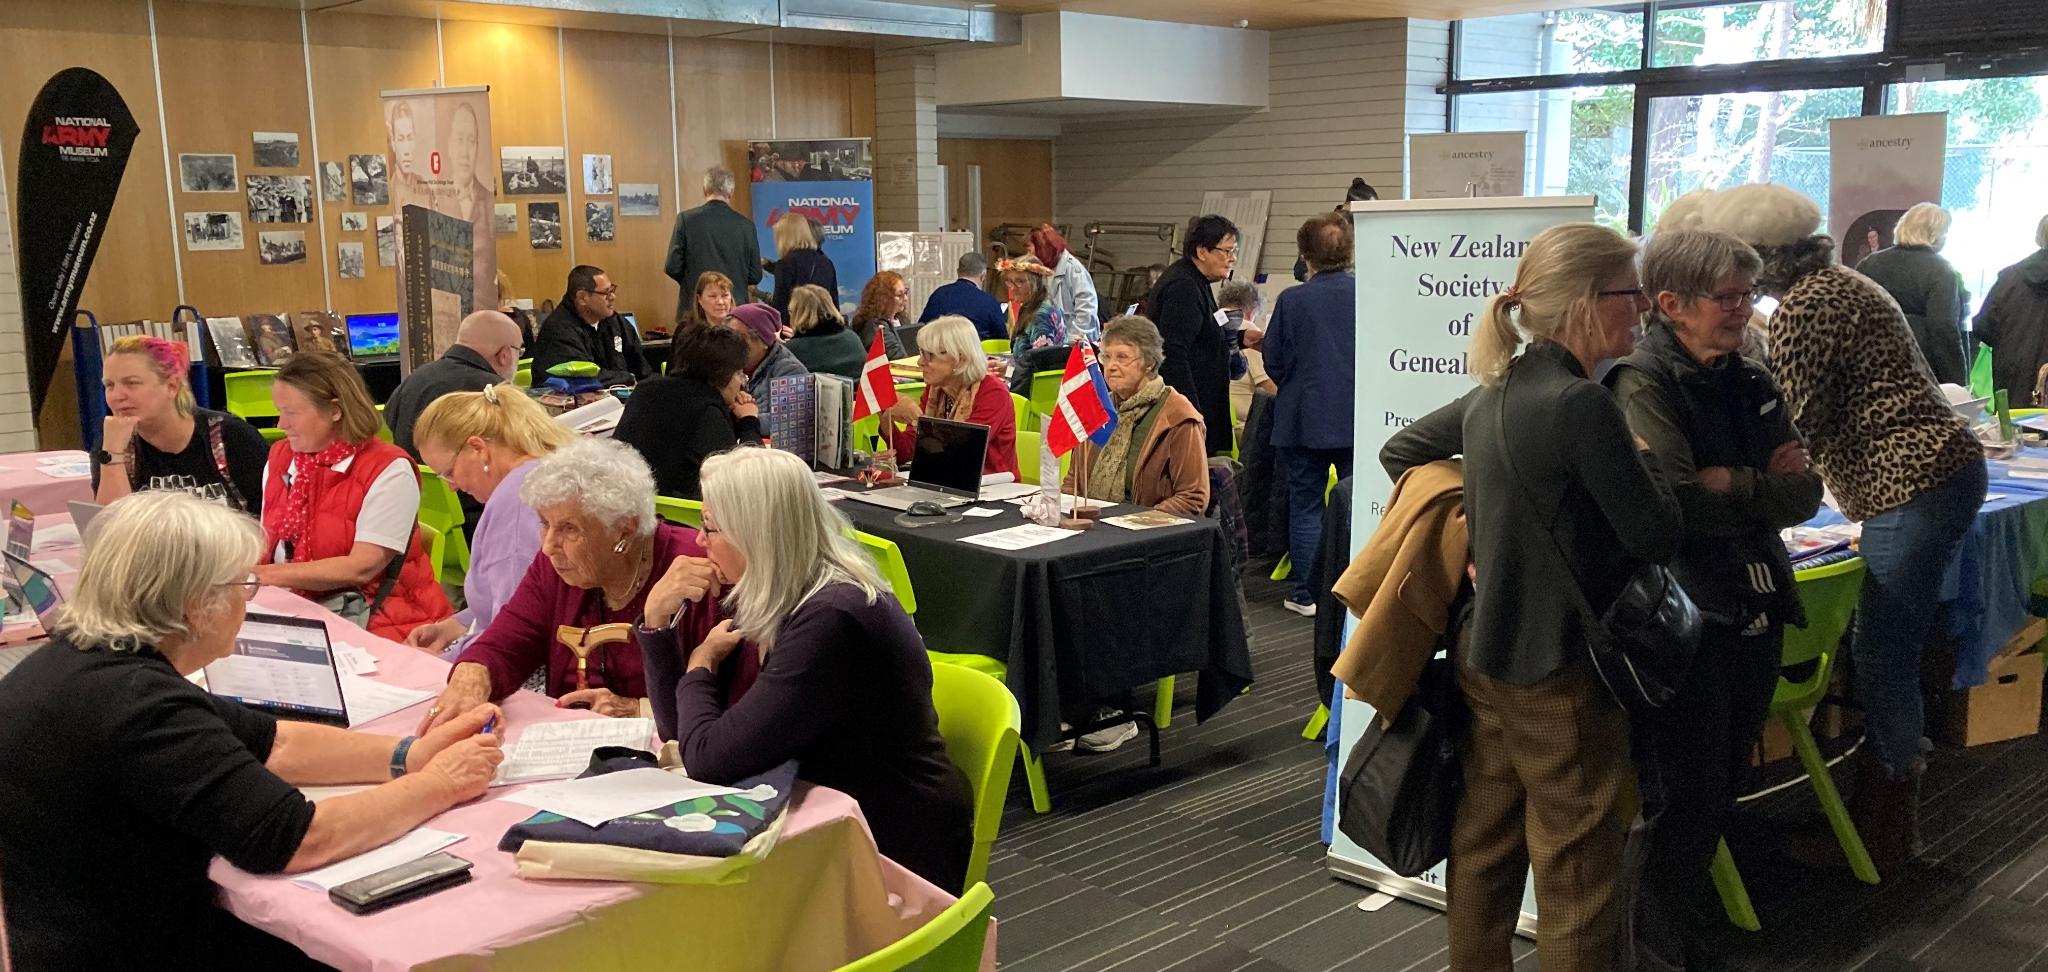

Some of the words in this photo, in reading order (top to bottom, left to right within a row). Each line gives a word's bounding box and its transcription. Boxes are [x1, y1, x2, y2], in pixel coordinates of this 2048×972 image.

[55, 116, 112, 127] NATIONAL
[42, 125, 111, 147] ARMY
[1868, 137, 1911, 150] ancestry
[59, 146, 108, 157] MUSEUM
[1452, 149, 1495, 161] ancestry
[788, 197, 860, 207] NATIONAL
[1391, 234, 1441, 259] New
[52, 211, 98, 334] www.armymuseum.co.nz
[1448, 313, 1474, 336] of
[1389, 348, 1469, 375] Geneal
